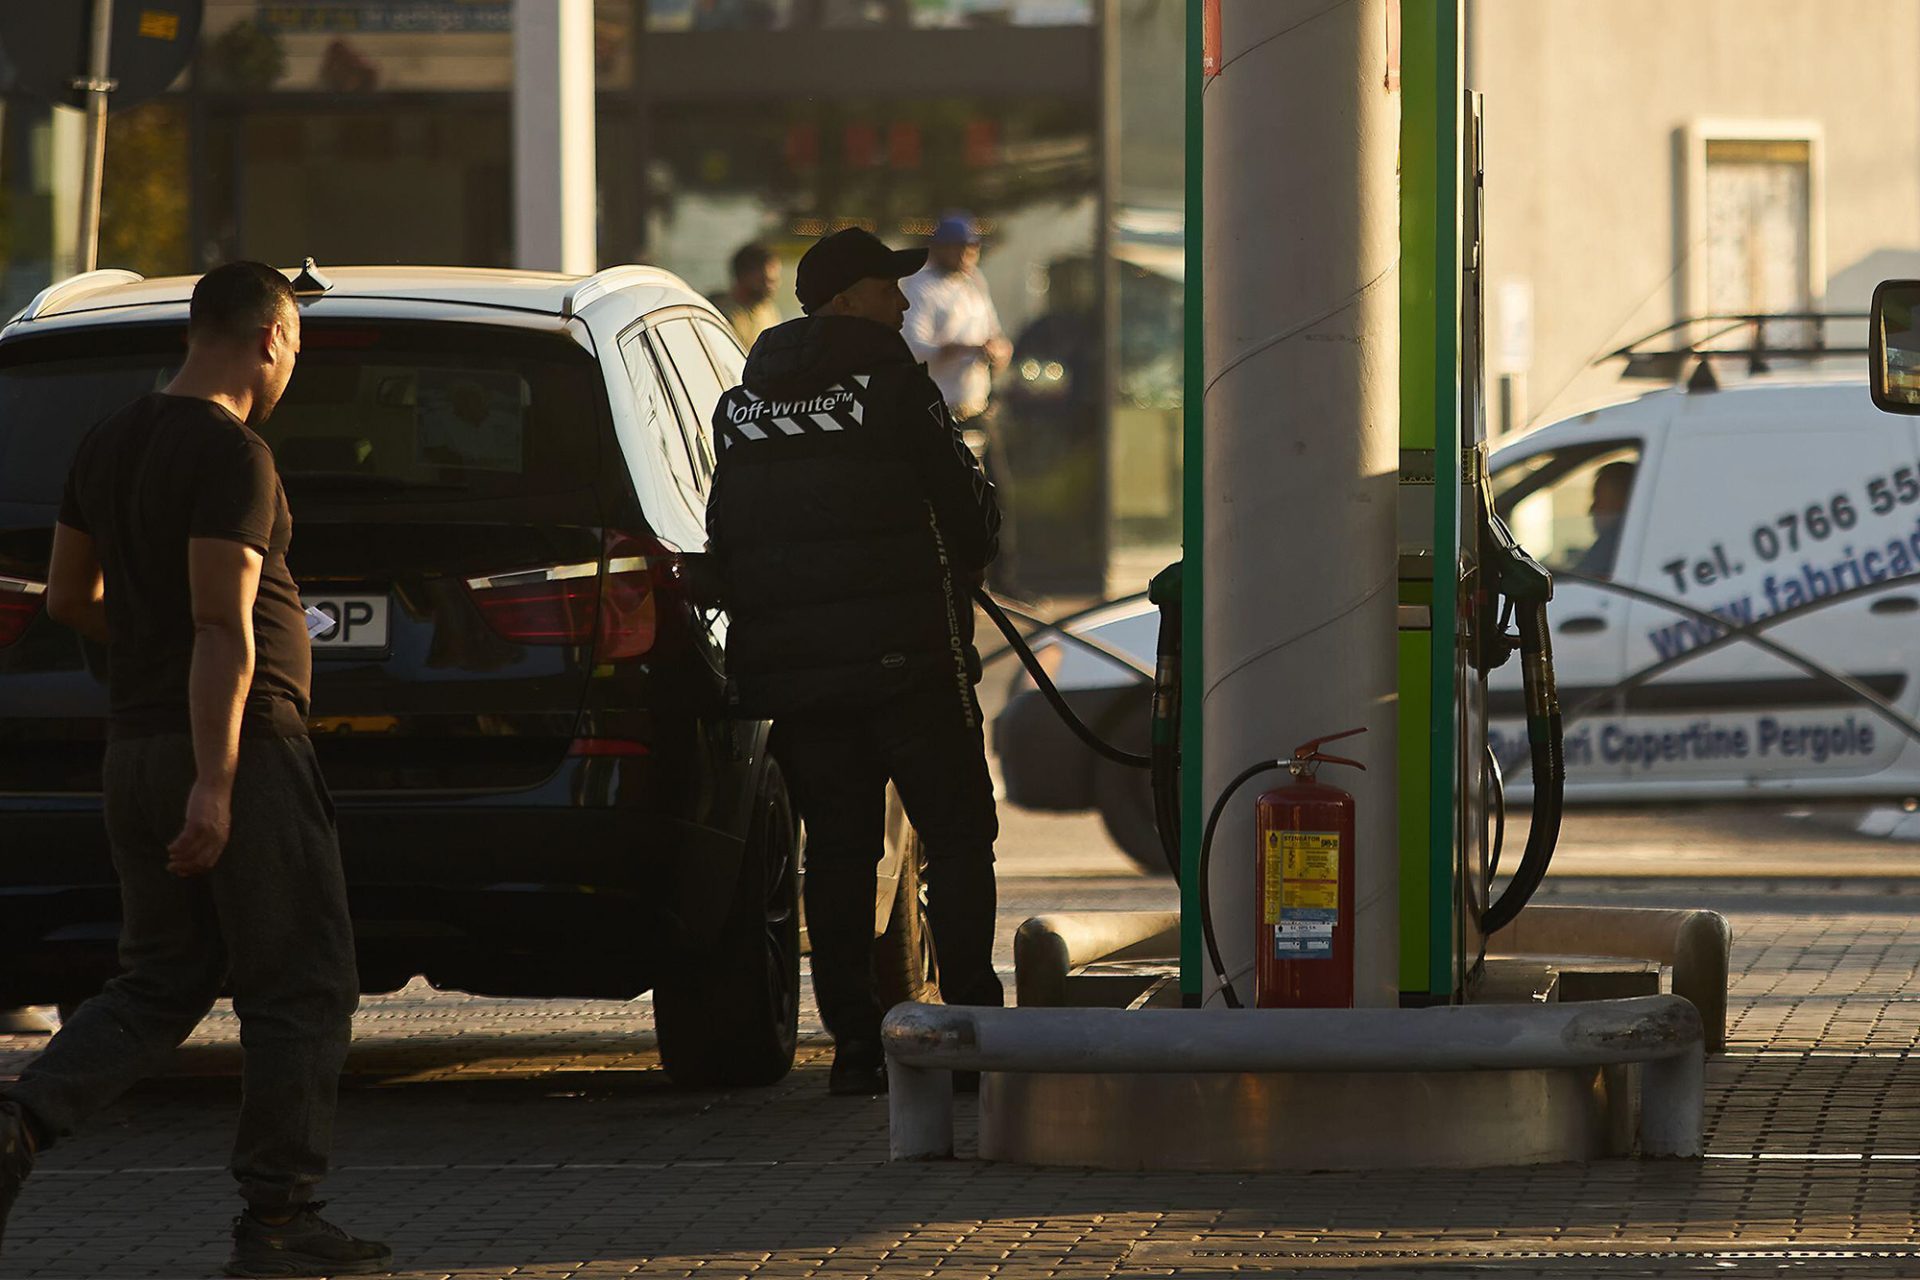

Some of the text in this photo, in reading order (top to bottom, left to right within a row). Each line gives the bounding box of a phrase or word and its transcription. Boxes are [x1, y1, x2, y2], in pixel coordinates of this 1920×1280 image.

[1663, 461, 1920, 594] Tel. 0766 55
[1601, 718, 1749, 768] Copertine
[1757, 715, 1874, 763] Pergole
